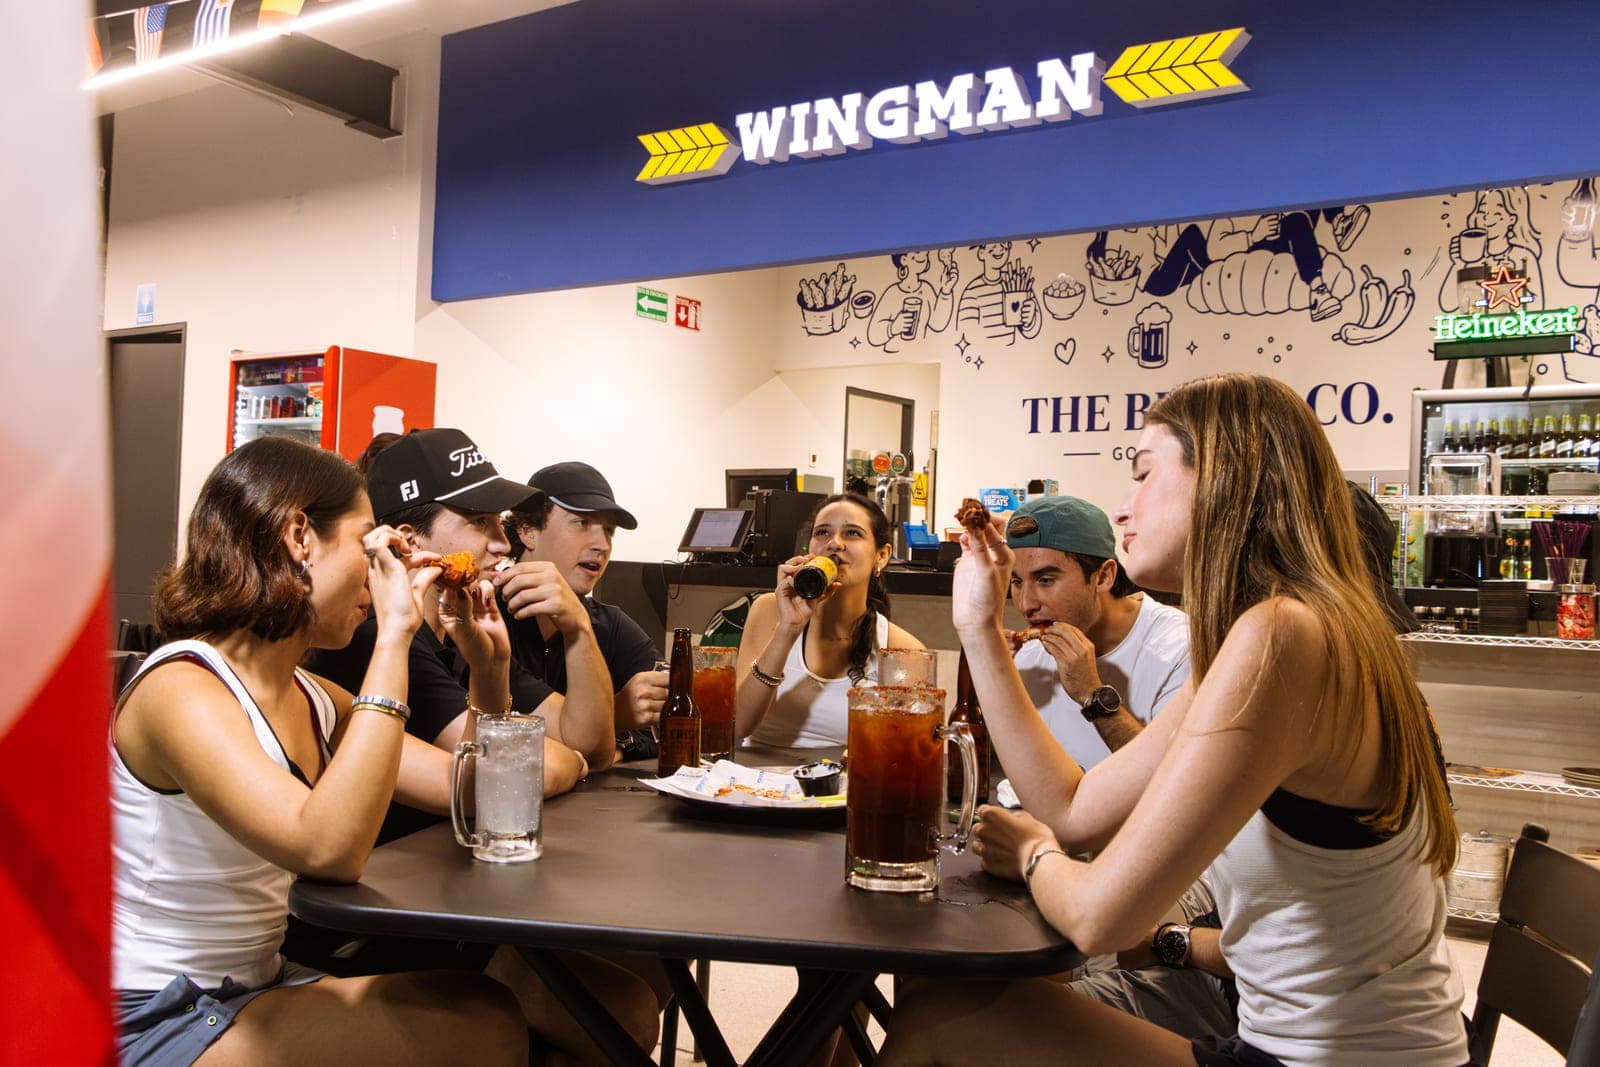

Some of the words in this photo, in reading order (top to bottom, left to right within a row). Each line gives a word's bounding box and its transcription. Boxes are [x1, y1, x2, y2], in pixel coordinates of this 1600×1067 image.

[735, 52, 1098, 163] WINGMAN
[1434, 309, 1577, 341] Heineken
[1022, 395, 1110, 434] THE
[1124, 391, 1170, 431] B
[1306, 382, 1394, 426] CO.
[1112, 446, 1137, 461] GO
[400, 480, 419, 502] FJ
